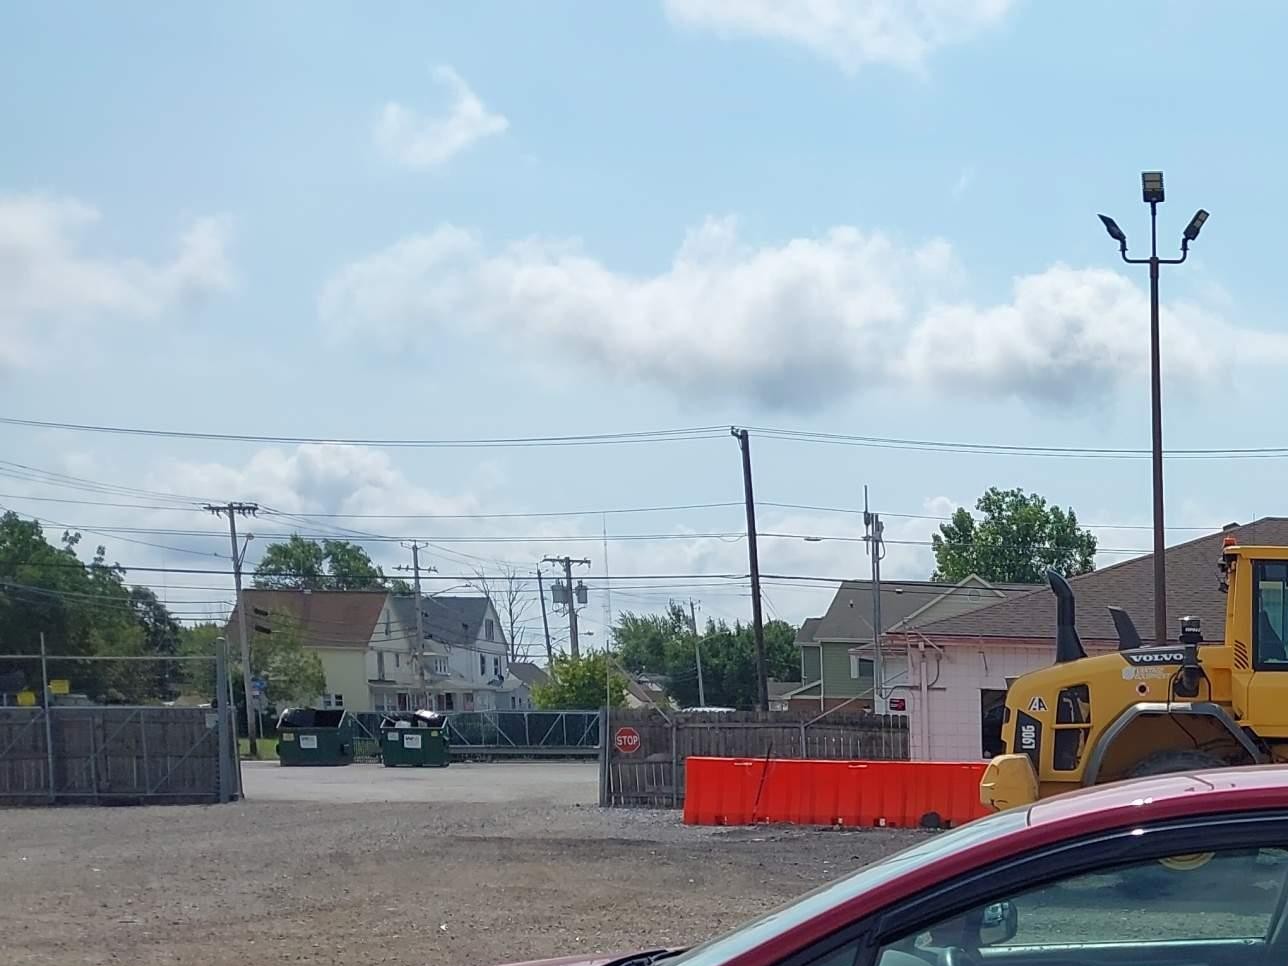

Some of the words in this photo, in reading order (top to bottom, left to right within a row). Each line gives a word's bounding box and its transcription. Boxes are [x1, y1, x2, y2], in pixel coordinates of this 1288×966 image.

[1130, 653, 1184, 662] VOLVO
[616, 735, 638, 746] STOP
[1021, 725, 1036, 749] L90G
